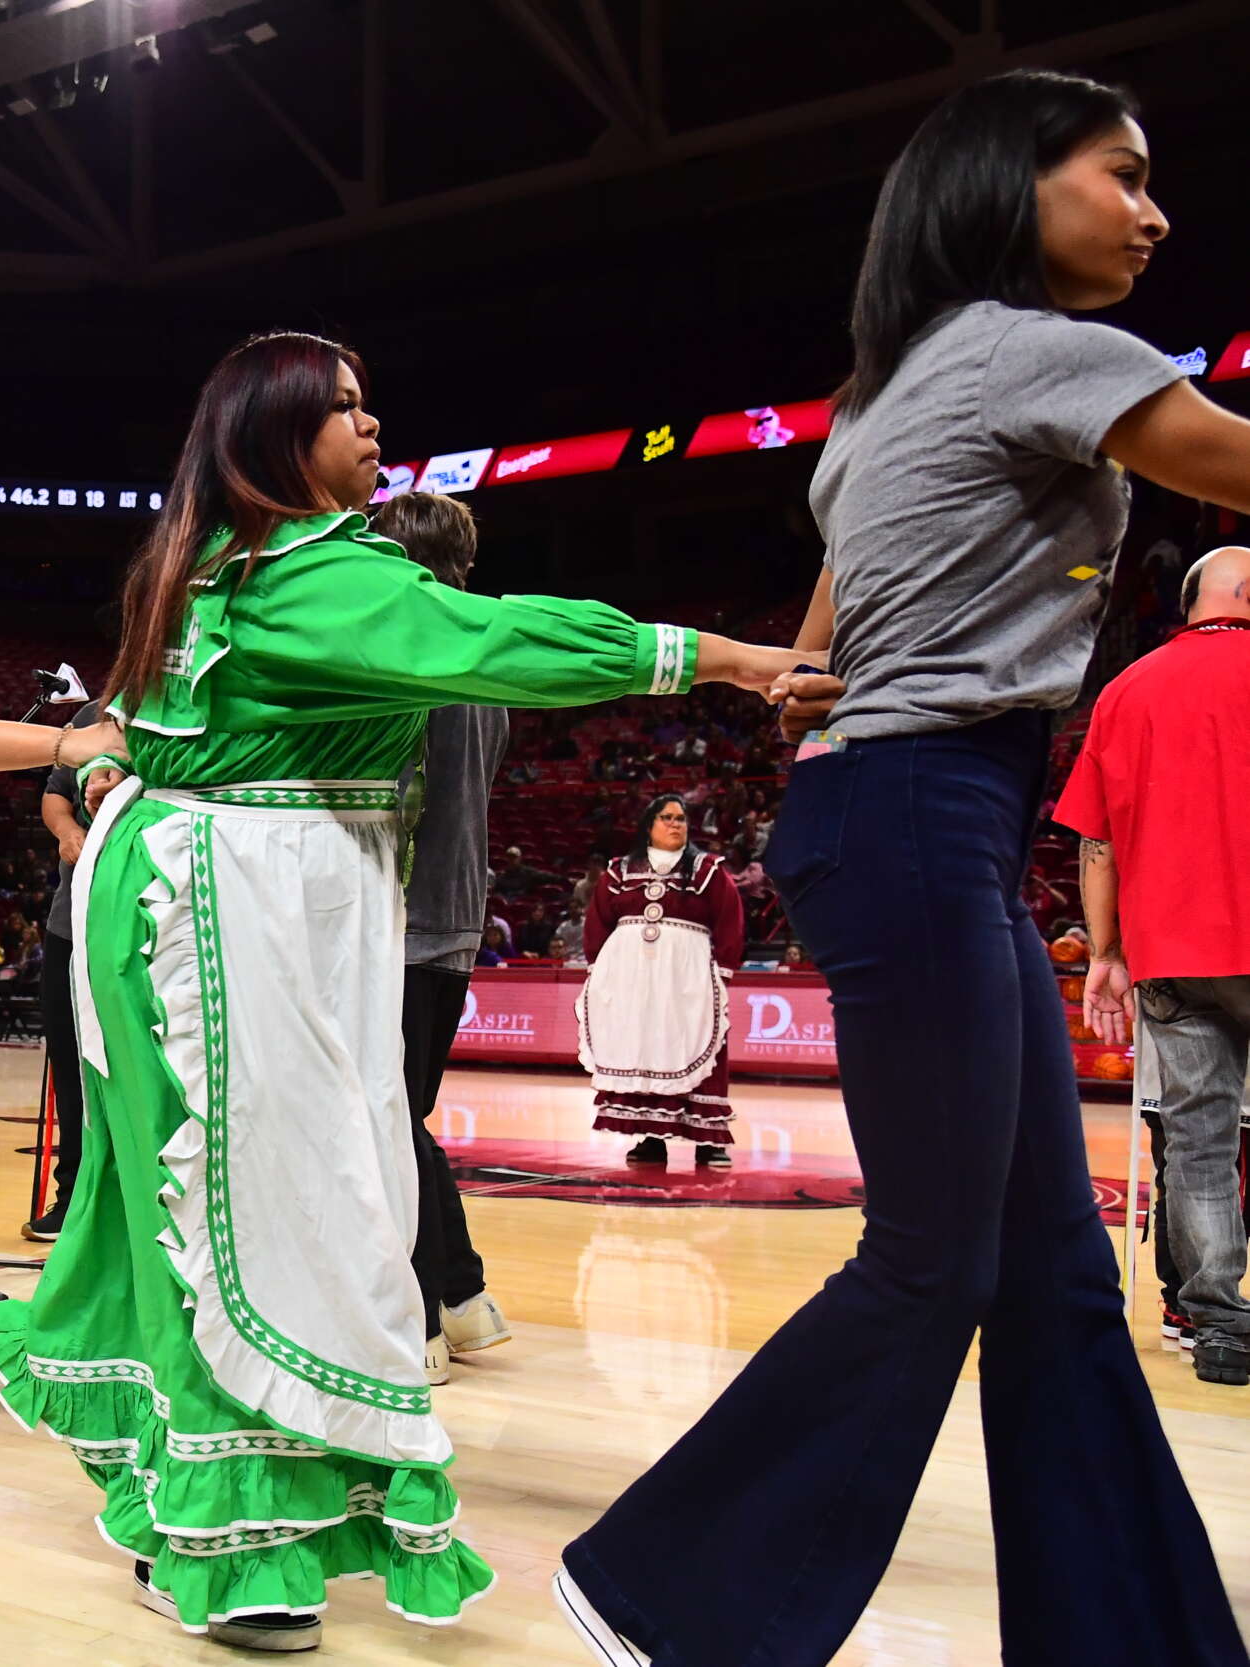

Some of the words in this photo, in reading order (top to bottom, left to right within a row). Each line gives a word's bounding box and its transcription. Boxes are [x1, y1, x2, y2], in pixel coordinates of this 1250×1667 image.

[10, 487, 49, 505] 46.2
[86, 490, 104, 507] 18
[746, 994, 833, 1040] DASP
